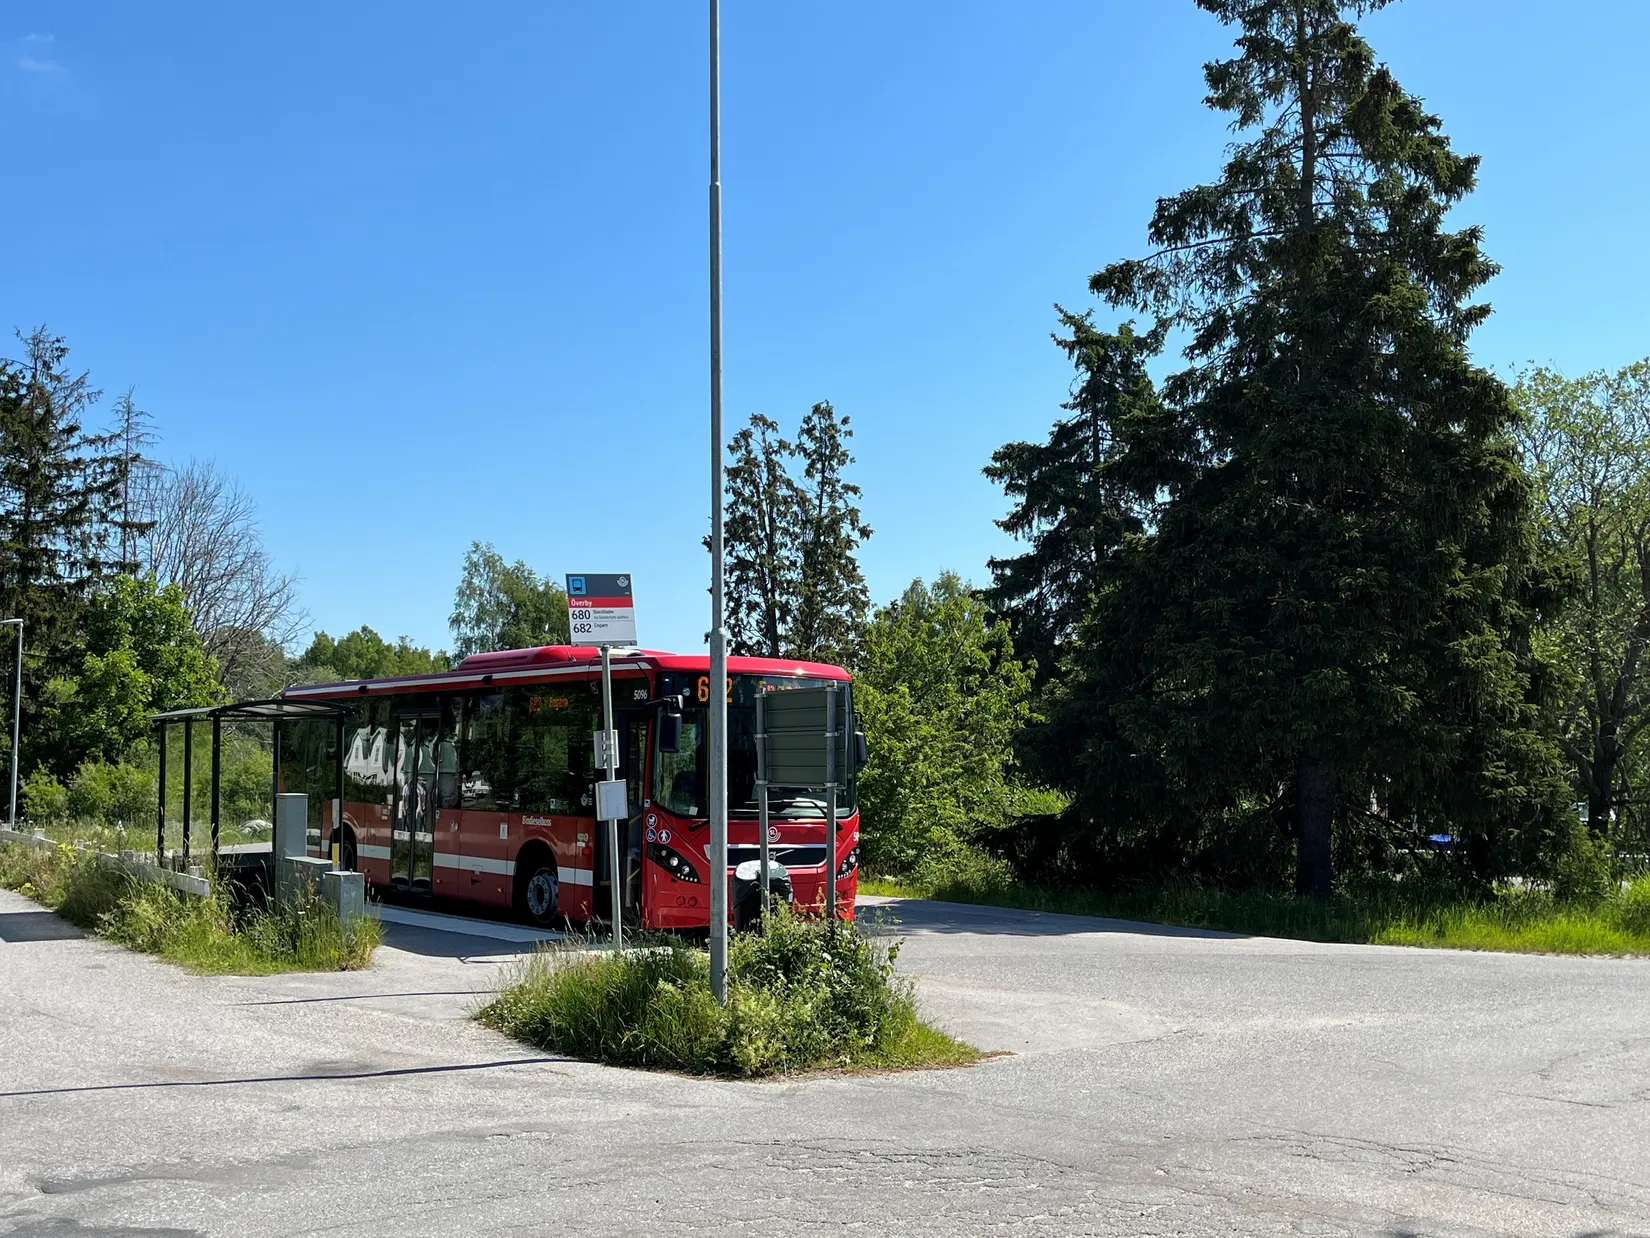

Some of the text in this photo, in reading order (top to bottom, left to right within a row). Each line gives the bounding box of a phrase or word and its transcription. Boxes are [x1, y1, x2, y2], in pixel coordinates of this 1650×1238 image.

[572, 609, 590, 620] 680
[574, 623, 592, 633] 682
[633, 689, 648, 700] 5096
[698, 676, 732, 702] 62
